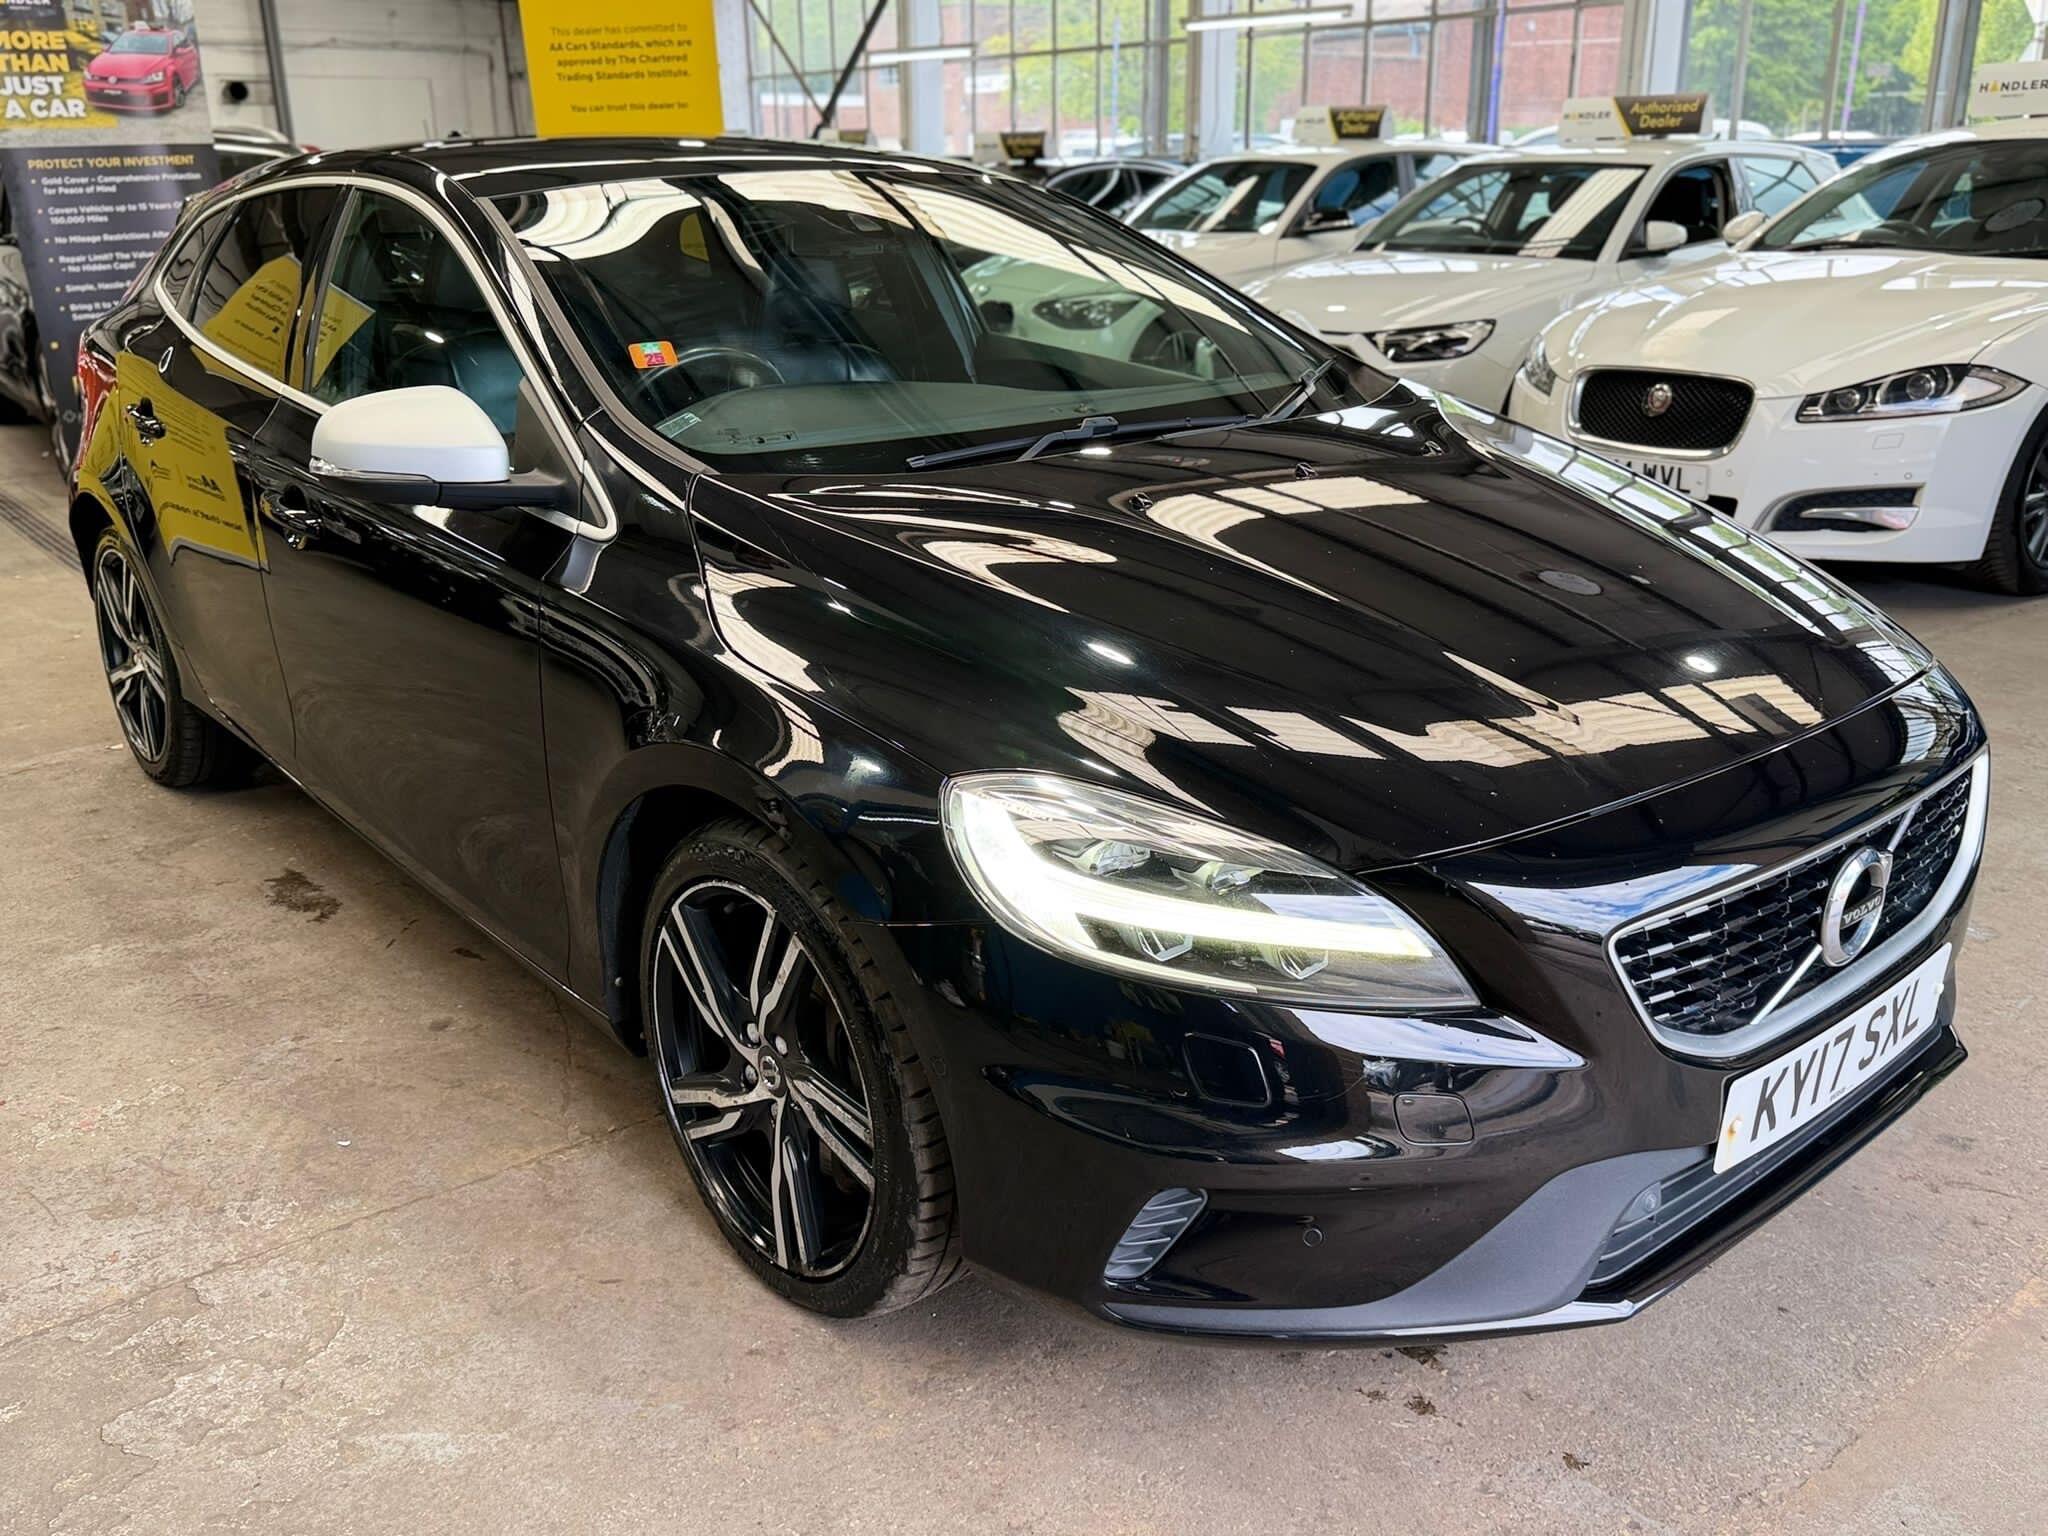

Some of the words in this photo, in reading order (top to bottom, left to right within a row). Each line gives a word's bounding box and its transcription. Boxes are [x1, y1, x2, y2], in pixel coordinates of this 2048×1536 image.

[551, 27, 570, 36] This
[573, 26, 602, 36] dealer
[605, 25, 621, 35] has
[624, 22, 675, 33] committed
[677, 22, 688, 32] to
[0, 30, 67, 50] MORE
[550, 42, 563, 51] AA
[566, 42, 588, 51] Cars
[590, 39, 642, 51] Standards,
[645, 39, 674, 48] which
[677, 39, 692, 47] are
[0, 53, 70, 72] THAN
[557, 56, 603, 67] approved
[605, 56, 617, 66] by
[619, 55, 636, 64] The
[639, 53, 688, 63] Chartered
[557, 72, 593, 83] Trading
[596, 70, 645, 80] Standards
[648, 69, 692, 79] Institute.
[0, 76, 64, 96] JUST
[5, 99, 26, 119] A
[30, 98, 86, 119] CAR
[570, 104, 587, 113] You
[607, 103, 627, 112] trust
[630, 102, 645, 110] this
[648, 101, 674, 110] dealer
[1630, 98, 1700, 115] Authorised
[1639, 114, 1684, 128] Dealer
[27, 158, 83, 169] PROTECT
[86, 156, 121, 168] YOUR
[123, 154, 195, 167] INVESTMENT
[41, 177, 63, 185] Gold
[64, 176, 89, 184] Cover
[97, 174, 161, 184] Comprehensive
[162, 172, 202, 181] Protection
[43, 187, 57, 195] for
[58, 186, 84, 194] Peace
[85, 185, 95, 193] of
[96, 184, 117, 193] Mind
[48, 207, 78, 215] Covers
[79, 205, 113, 213] Vehicles
[115, 205, 126, 214] up
[128, 203, 137, 211] to
[138, 203, 147, 211] 15
[148, 202, 172, 210] Years
[87, 215, 109, 223] Miles
[69, 235, 101, 244] Mileage
[103, 232, 151, 242] Restrictions
[58, 255, 86, 264] Repair
[115, 251, 131, 260] The
[68, 265, 80, 273] No
[82, 263, 112, 272] Hidden
[65, 284, 97, 294] Simple,
[69, 303, 93, 312] Bring
[645, 352, 665, 365] 25
[1643, 462, 1692, 495] WVL
[1843, 895, 1882, 924] VOLVO
[1749, 1024, 1857, 1143] KY17
[1858, 979, 1920, 1071] SXL
